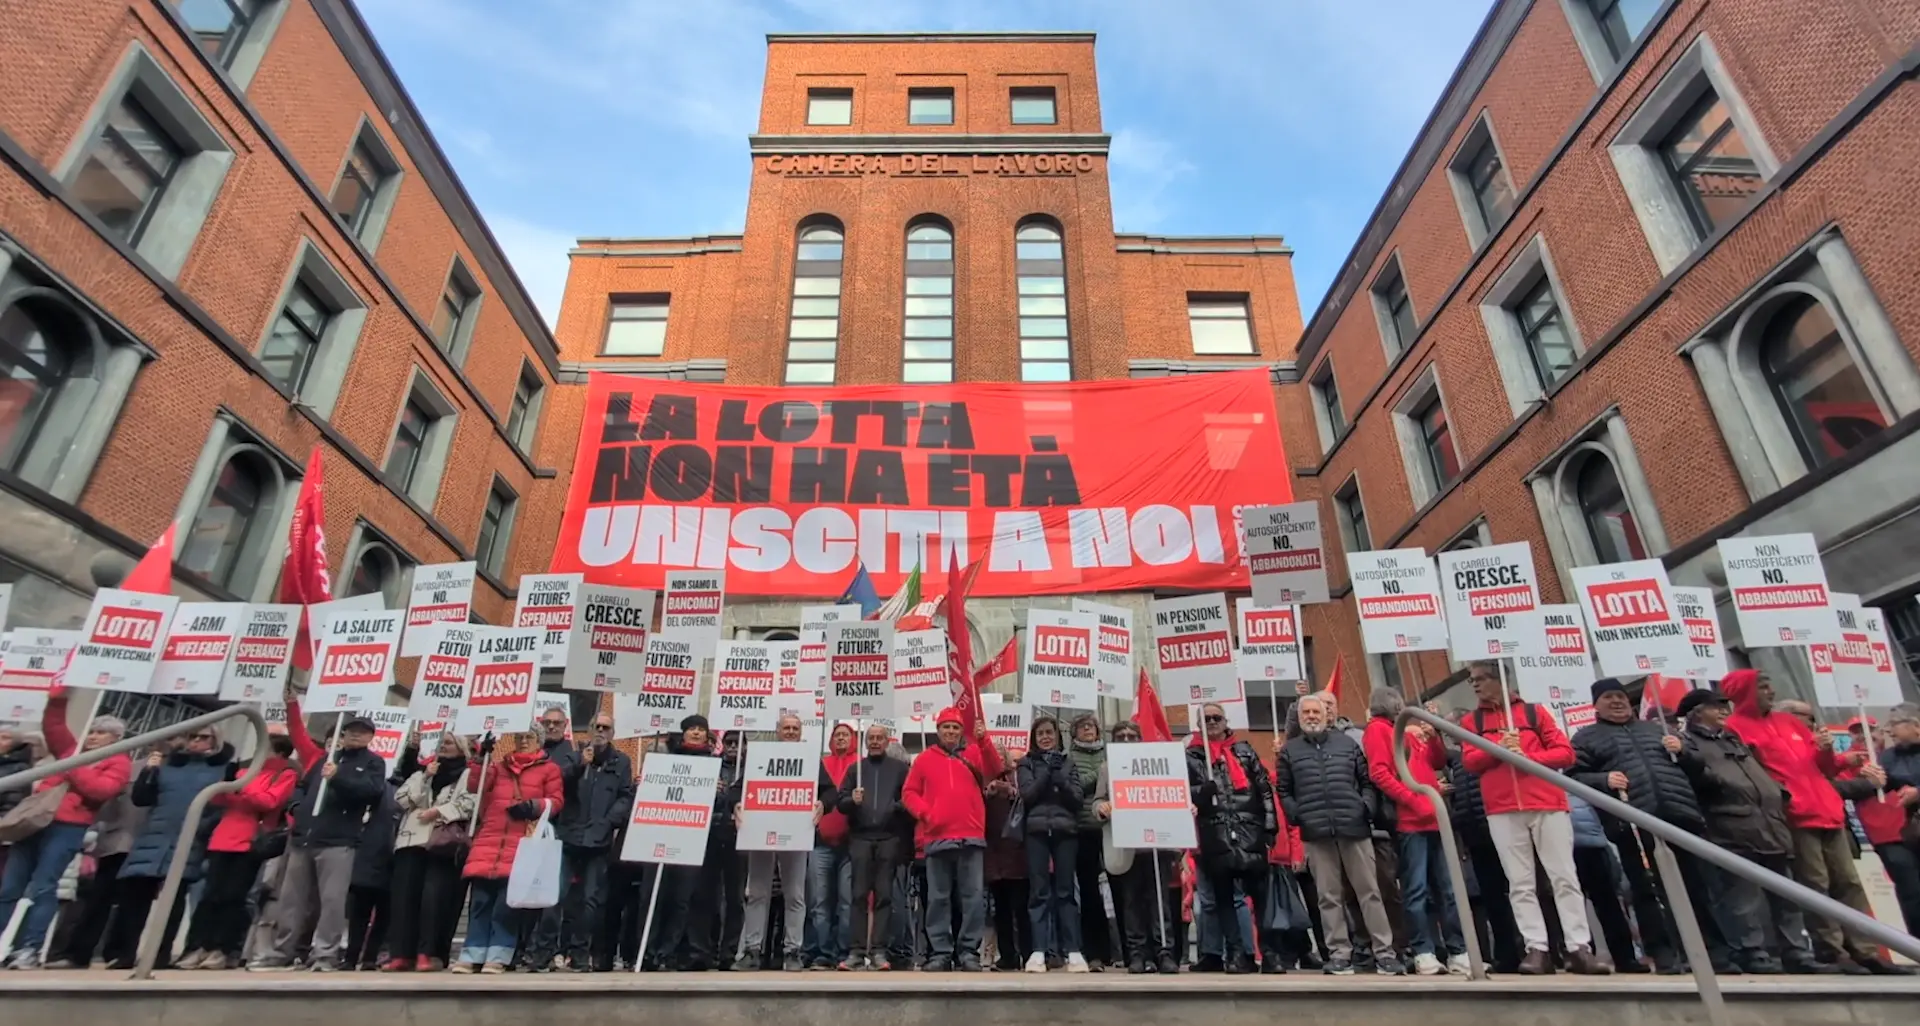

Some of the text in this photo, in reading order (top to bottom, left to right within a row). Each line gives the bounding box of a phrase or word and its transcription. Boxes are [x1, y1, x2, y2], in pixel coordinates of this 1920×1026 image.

[766, 153, 1093, 175] CAMERA DEL LAVORO
[601, 391, 976, 449] LA LOTTA
[588, 435, 1082, 507] NON HA ETÀ
[1269, 512, 1290, 524] NON
[1247, 521, 1316, 538] AUTOSUFFICIENTI?
[578, 504, 968, 574] UNISCITI
[988, 511, 1053, 571] A
[1068, 503, 1224, 567] NOI
[1272, 535, 1293, 551] NO,
[1754, 544, 1780, 557] NON
[1252, 553, 1320, 573] ABBANDONATI.
[1376, 558, 1398, 569] NON
[1452, 556, 1501, 571] IL CARRELLO
[1728, 555, 1815, 569] AUTOSUFFICIENTI?
[436, 570, 453, 581] NON
[1354, 567, 1425, 581] AUTOSUFFICIENTI?
[1455, 564, 1527, 591] CRESCE,
[1611, 571, 1625, 580] CHI
[1762, 568, 1789, 584] NO,
[414, 578, 472, 592] AUTOSUFFICIENTI?
[532, 580, 569, 591] PENSIONI
[671, 579, 719, 590] NON SIAMO IL
[1382, 579, 1405, 595] NO,
[527, 592, 570, 606] FUTURE?
[587, 594, 630, 606] IL CARRELLO
[667, 596, 720, 611] BANCOMAT
[1457, 592, 1532, 611] LE PENSIONI
[1593, 589, 1664, 619] LOTTA
[1738, 588, 1826, 606] ABBANDONATI.
[1362, 598, 1434, 615] ABBANDONATI.
[253, 611, 288, 622] PENSIONI
[409, 607, 466, 623] ABBANDONATI.
[519, 611, 572, 627] SPERANZE
[585, 604, 645, 628] CRESCE,
[667, 616, 717, 627] DEL GOVERNO.
[823, 612, 839, 622] NON
[1157, 605, 1223, 626] IN PENSIONE
[1484, 615, 1506, 631] NO!
[1568, 614, 1576, 626] IL
[95, 615, 157, 641] LOTTA
[189, 616, 227, 632] ARMI
[246, 624, 288, 638] FUTURE?
[333, 618, 396, 635] LA SALUTE
[1120, 618, 1127, 629] IL
[1174, 623, 1206, 634] MA NON IN
[1247, 616, 1292, 637] LOTTA
[583, 624, 644, 650] LE PENSIONI
[841, 628, 880, 639] PENSIONI
[1595, 623, 1684, 643] NON INVECCHIA!
[174, 641, 230, 656] WELFARE
[479, 636, 538, 654] LA SALUTE
[650, 640, 690, 653] PENSIONI
[837, 640, 883, 655] FUTURE?
[907, 637, 924, 648] NON
[1037, 634, 1088, 659] LOTTA
[1242, 645, 1258, 655] NON
[77, 646, 98, 657] NON
[100, 648, 156, 663] INVECCHIA!
[236, 643, 286, 659] SPERANZE
[491, 655, 505, 663] NON
[509, 654, 518, 662] UN
[597, 651, 617, 666] NO!
[730, 647, 768, 657] PENSIONI
[1161, 638, 1229, 664] SILENZIO!
[323, 653, 385, 677] LUSSO
[645, 652, 692, 669] FUTURE?
[725, 659, 770, 671] FUTURE?
[832, 660, 887, 677] SPERANZE
[1520, 655, 1587, 668] DEL GOVERNO.
[234, 664, 277, 679] PASSATE.
[1027, 664, 1095, 680] NON INVECCHIA!
[424, 682, 463, 699] PASSA
[472, 672, 529, 698] LUSSO
[719, 675, 772, 691] SPERANZE
[835, 682, 884, 697] PASSATE.
[637, 693, 687, 710] PASSATE.
[720, 696, 767, 709] PASSATE.
[374, 711, 406, 724] SALUTE
[995, 715, 1021, 728] ARMI
[671, 762, 692, 774] NON
[766, 758, 804, 777] ARMI
[1131, 758, 1171, 776] ARMI
[643, 773, 714, 788] AUTOSUFFICIENTI?
[665, 787, 685, 803] NO,
[756, 787, 813, 806] WELFARE
[1125, 785, 1185, 804] WELFARE
[635, 806, 707, 825] ABBANDONATI.
